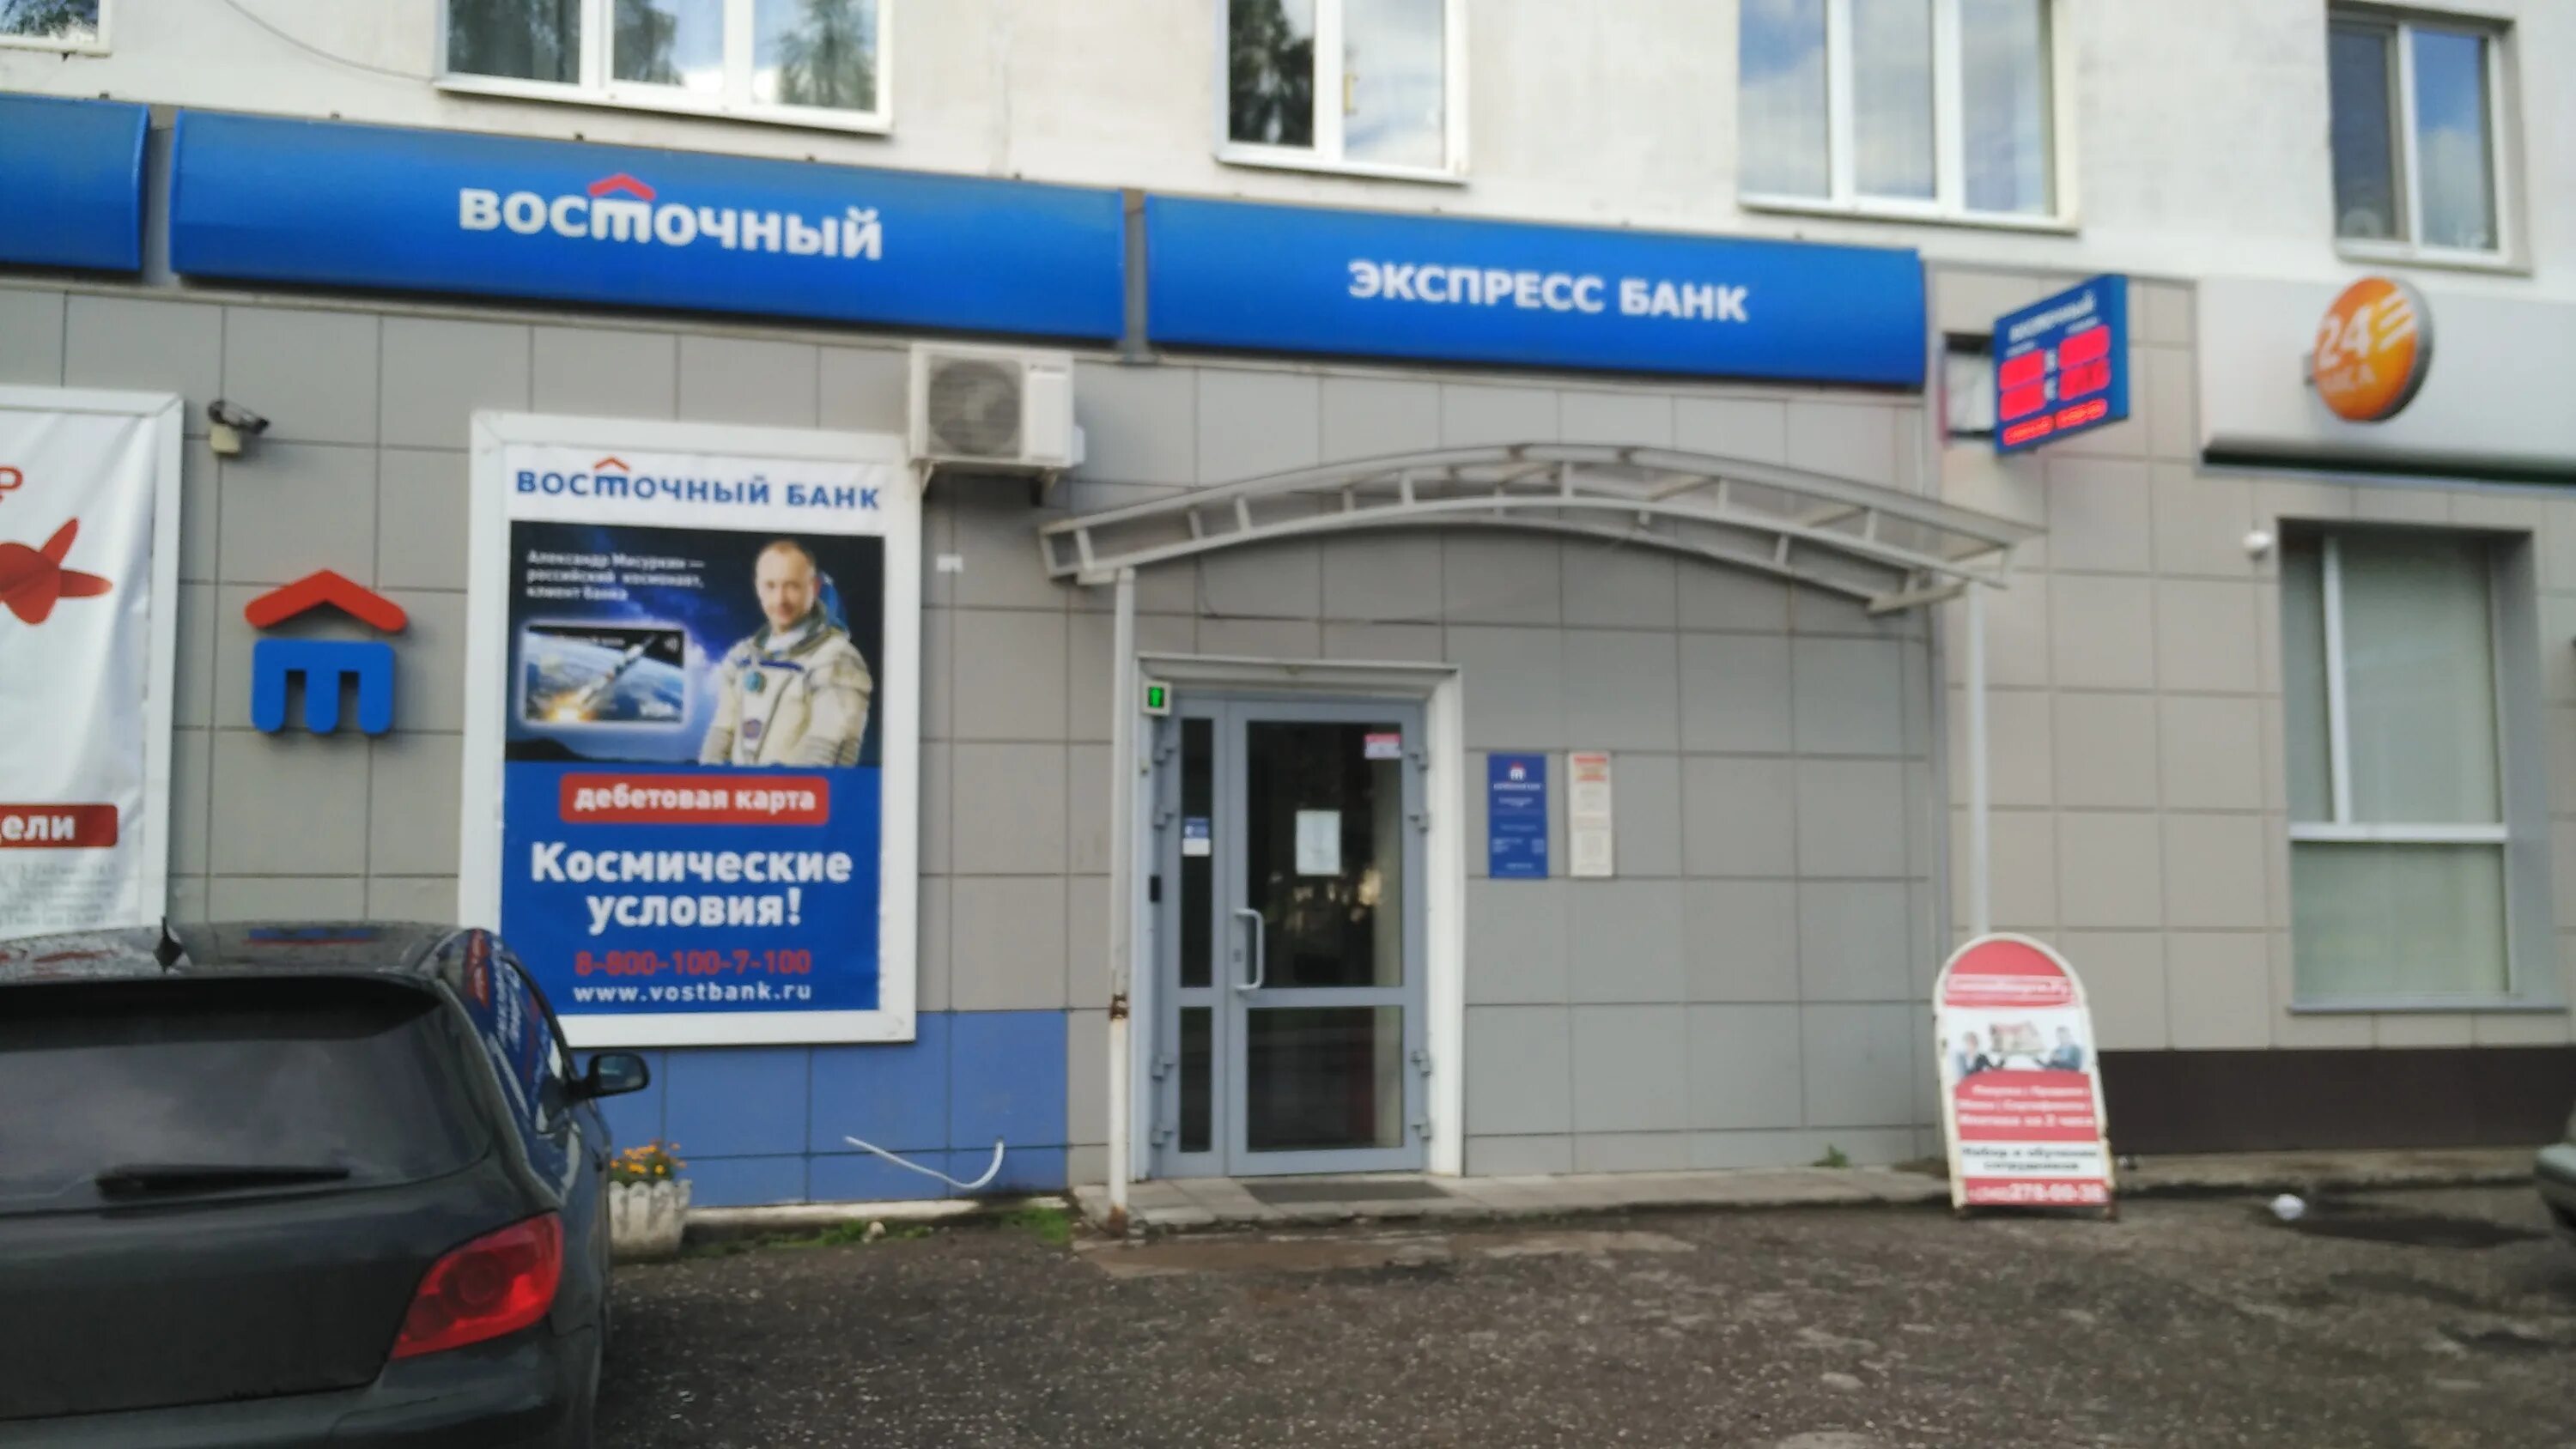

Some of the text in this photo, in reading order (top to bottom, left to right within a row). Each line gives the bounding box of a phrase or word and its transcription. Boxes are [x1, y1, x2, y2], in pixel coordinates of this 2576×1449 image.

[1348, 259, 1749, 323] ЭКСПРЕСС БАНК
[2318, 305, 2372, 371] 24
[786, 483, 881, 510] БАНК
[574, 784, 816, 815] дебетовая карта
[0, 815, 76, 842] ели
[531, 841, 853, 883] Космические
[586, 888, 801, 936] условия!
[574, 950, 811, 977] 8-800-100-7-100
[574, 980, 811, 1002] www.vostbank.ru
